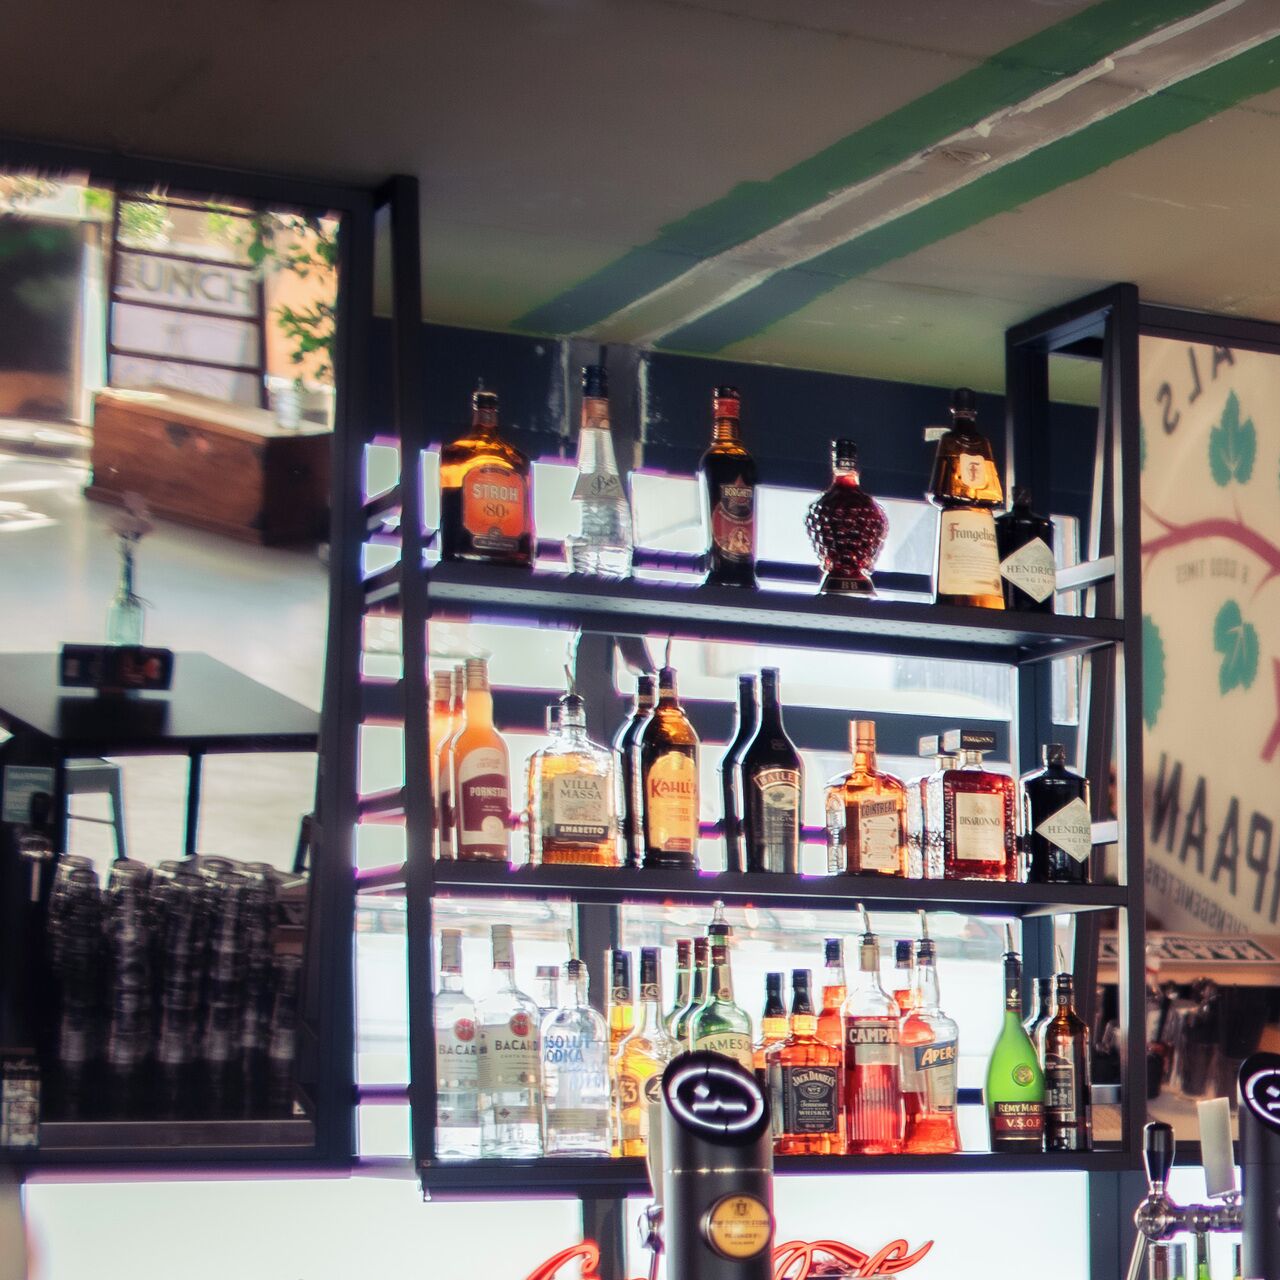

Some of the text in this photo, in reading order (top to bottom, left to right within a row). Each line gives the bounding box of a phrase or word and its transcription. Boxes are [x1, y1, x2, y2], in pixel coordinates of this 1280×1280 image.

[472, 483, 518, 501] STROH
[1006, 564, 1056, 576] HENDRIC
[563, 779, 598, 790] VILLA
[560, 790, 603, 800] MASSA
[959, 816, 1000, 826] DISARONNO
[560, 825, 605, 835] AMARETTO
